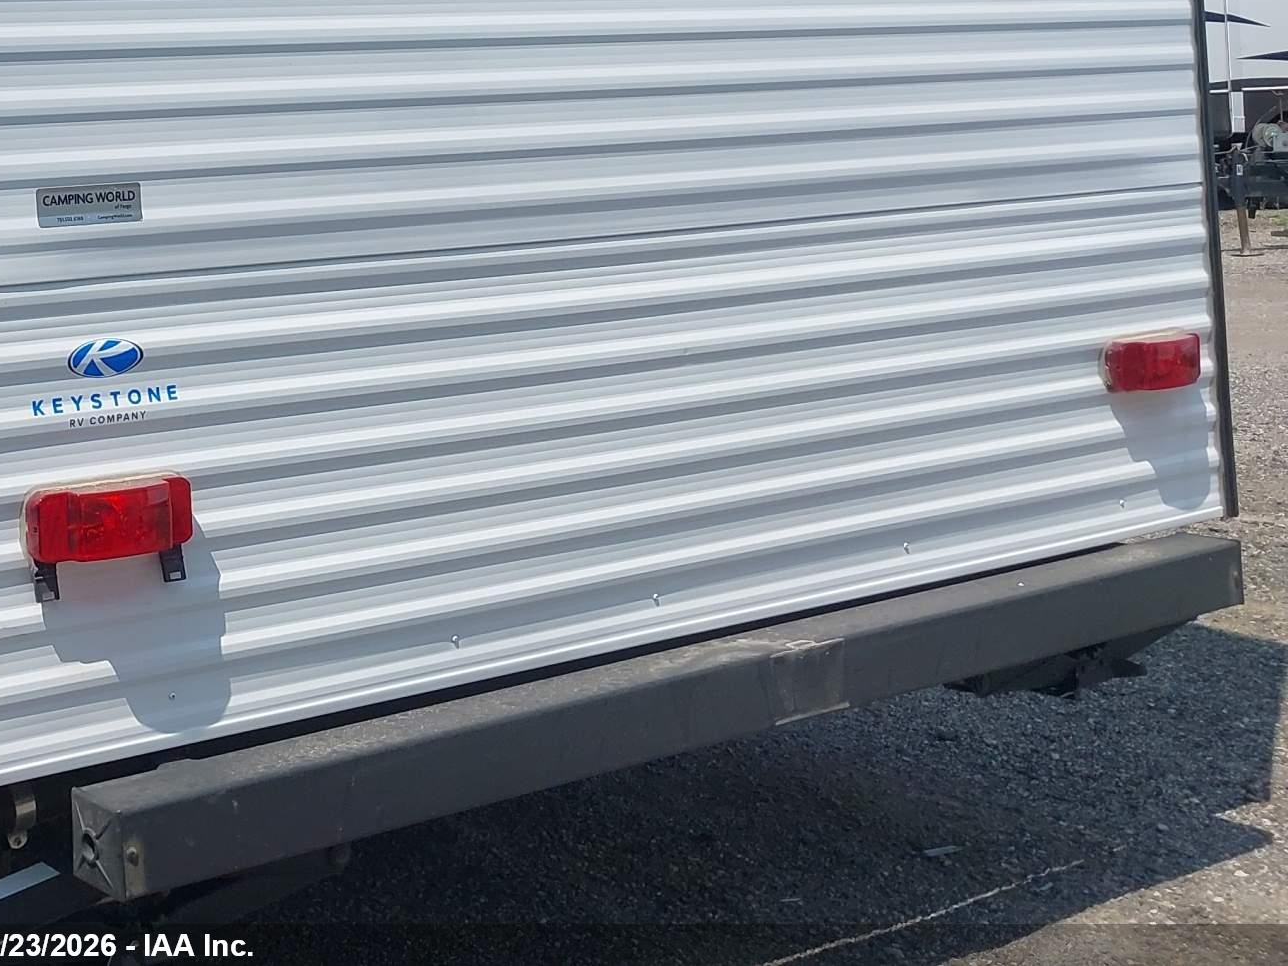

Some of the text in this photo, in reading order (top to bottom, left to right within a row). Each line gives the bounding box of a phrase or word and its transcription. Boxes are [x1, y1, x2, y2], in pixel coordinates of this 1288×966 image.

[42, 190, 136, 207] CAMPING WORLD
[31, 384, 179, 417] KEYSTONE
[68, 410, 148, 428] RV COMPANY
